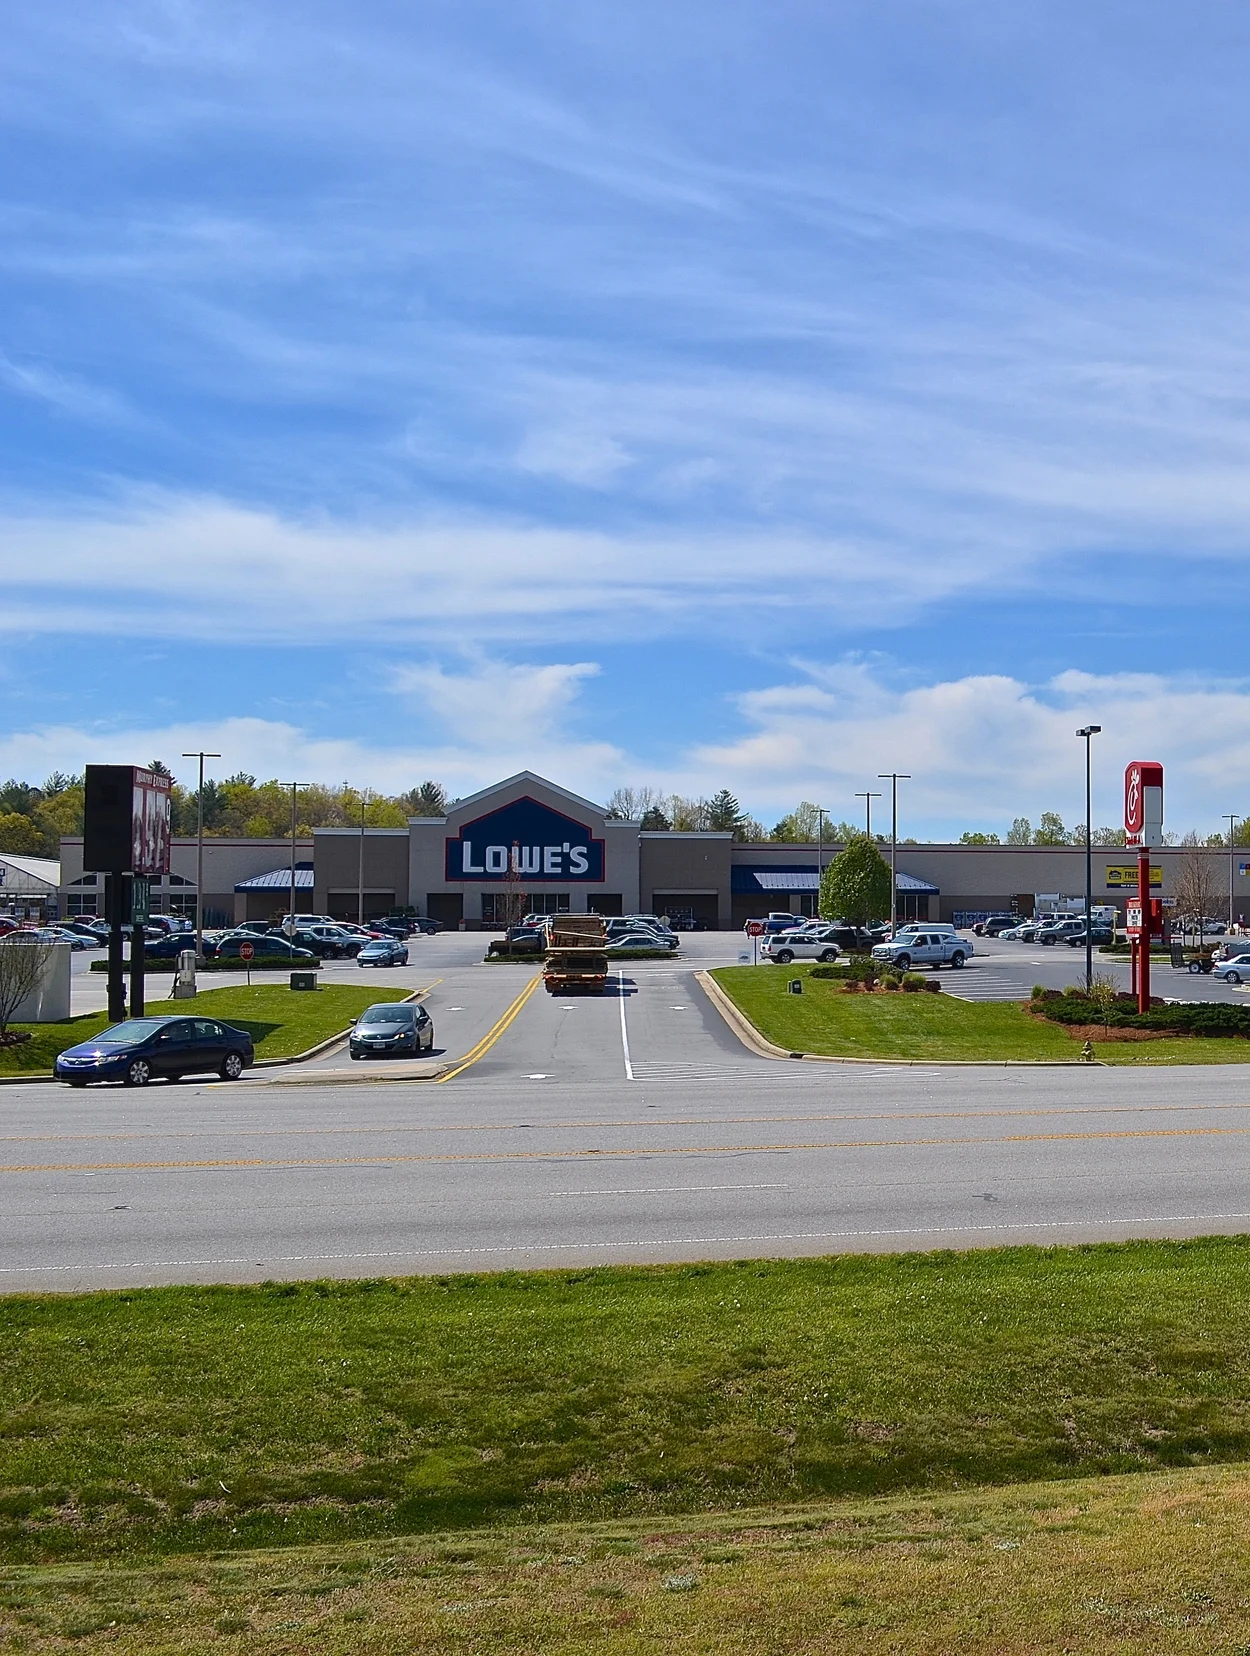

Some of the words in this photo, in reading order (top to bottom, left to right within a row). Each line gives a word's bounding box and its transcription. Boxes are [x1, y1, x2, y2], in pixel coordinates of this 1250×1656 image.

[462, 841, 589, 874] LOWE'S
[1124, 871, 1139, 879] FREE
[241, 947, 253, 955] STOP
